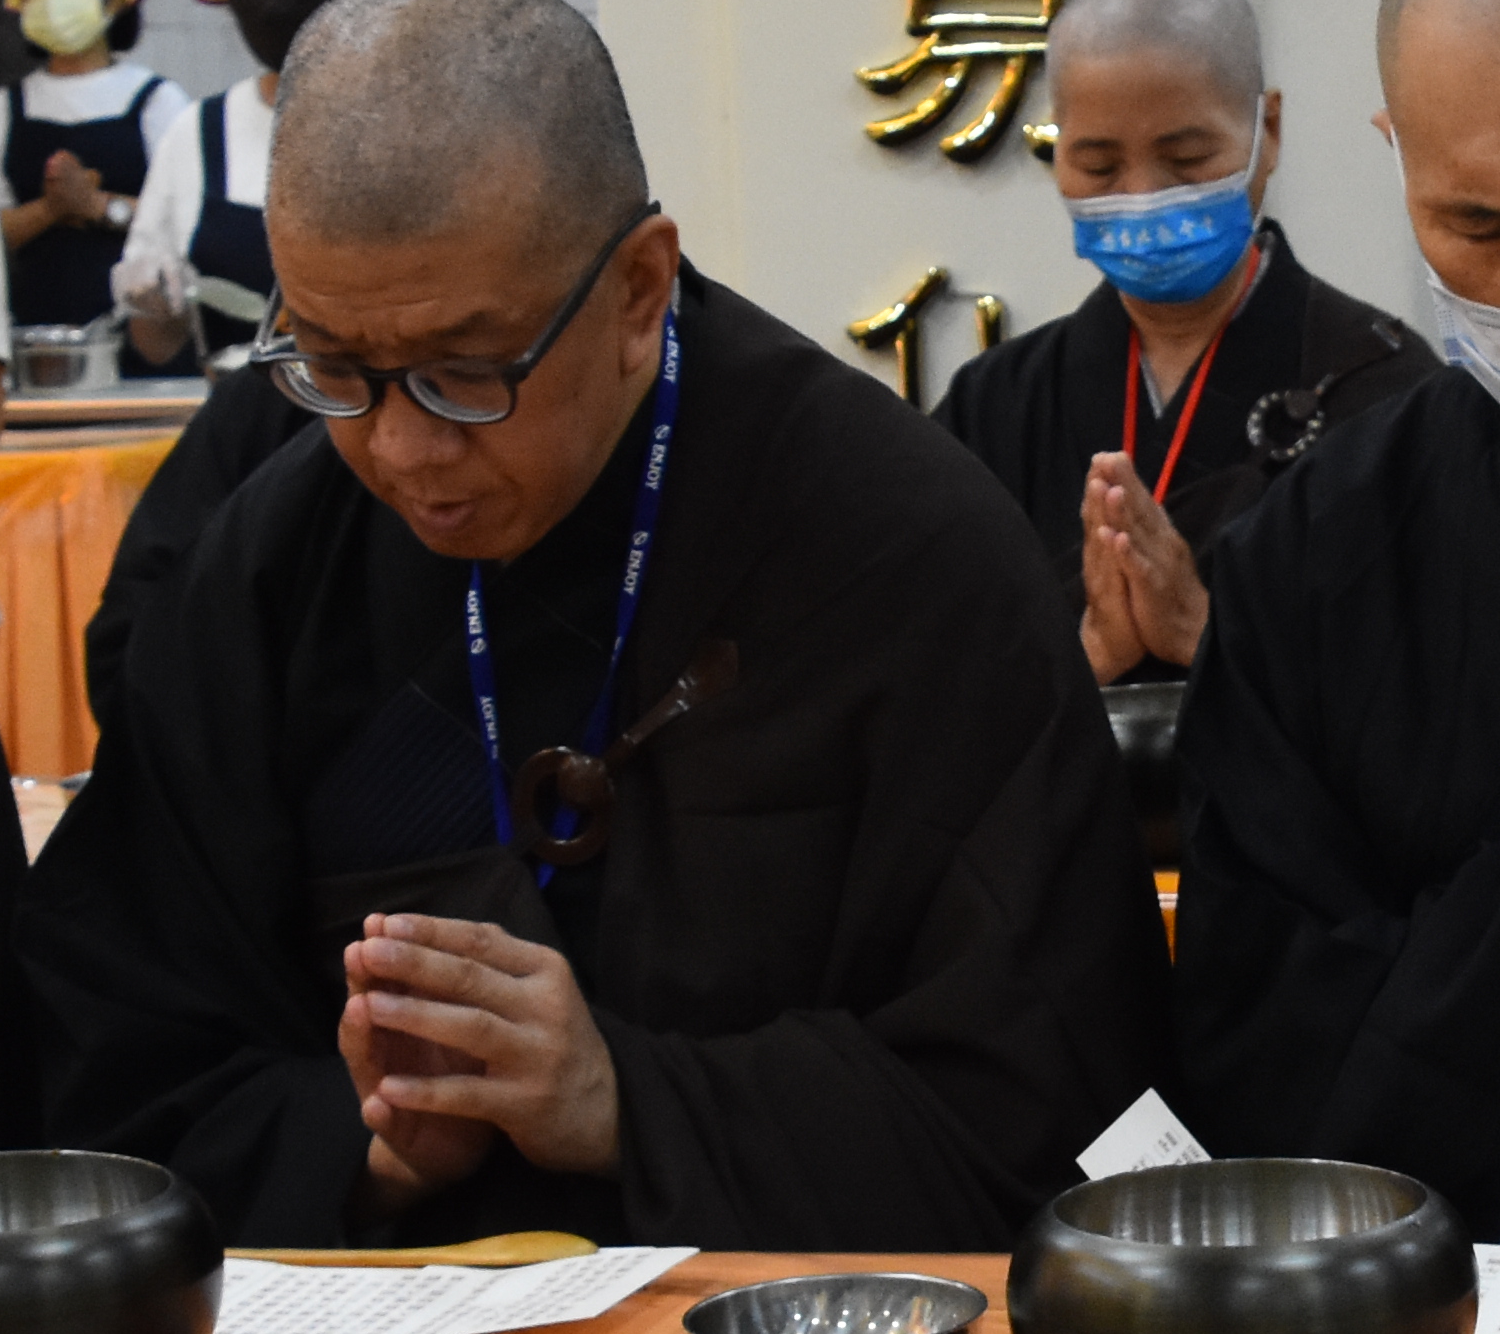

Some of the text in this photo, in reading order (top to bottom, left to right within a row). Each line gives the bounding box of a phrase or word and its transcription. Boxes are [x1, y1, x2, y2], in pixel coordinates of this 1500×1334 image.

[663, 339, 681, 384] ENJOY
[645, 443, 668, 491] ENJOY
[623, 549, 645, 596] ENJOY
[467, 588, 483, 635] ENJOY
[479, 695, 498, 741] ENJOY
